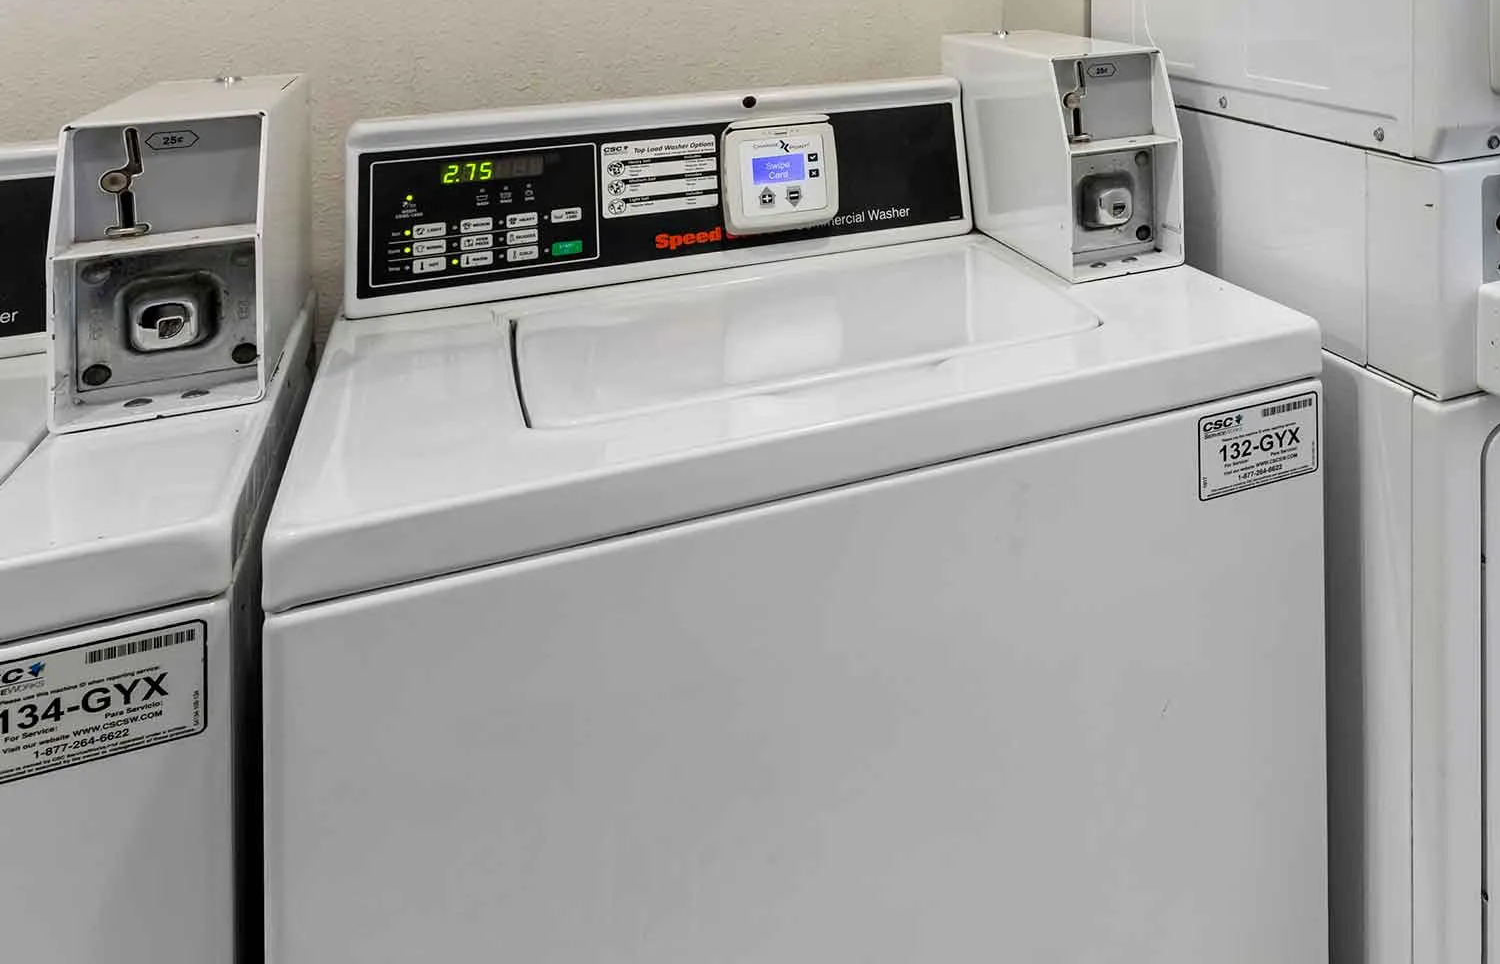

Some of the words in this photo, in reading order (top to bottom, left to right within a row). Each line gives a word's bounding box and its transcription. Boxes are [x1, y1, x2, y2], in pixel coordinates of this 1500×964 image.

[646, 145, 663, 153] Load
[664, 143, 689, 151] Washer
[442, 161, 494, 184] 2.75
[832, 211, 865, 226] ercial
[867, 207, 910, 221] Washer
[655, 226, 722, 250] Speed
[1203, 417, 1234, 432] CSC
[1219, 427, 1300, 462] 132-GYX
[0, 672, 169, 734] 134-GYX
[104, 709, 124, 720] Para
[1, 744, 21, 755] Visit
[22, 742, 37, 751] our
[39, 734, 70, 747] website
[72, 709, 163, 738] WWW.CSCSW.COM
[4, 731, 21, 743] For
[33, 728, 130, 759] 1-877-264-6622
